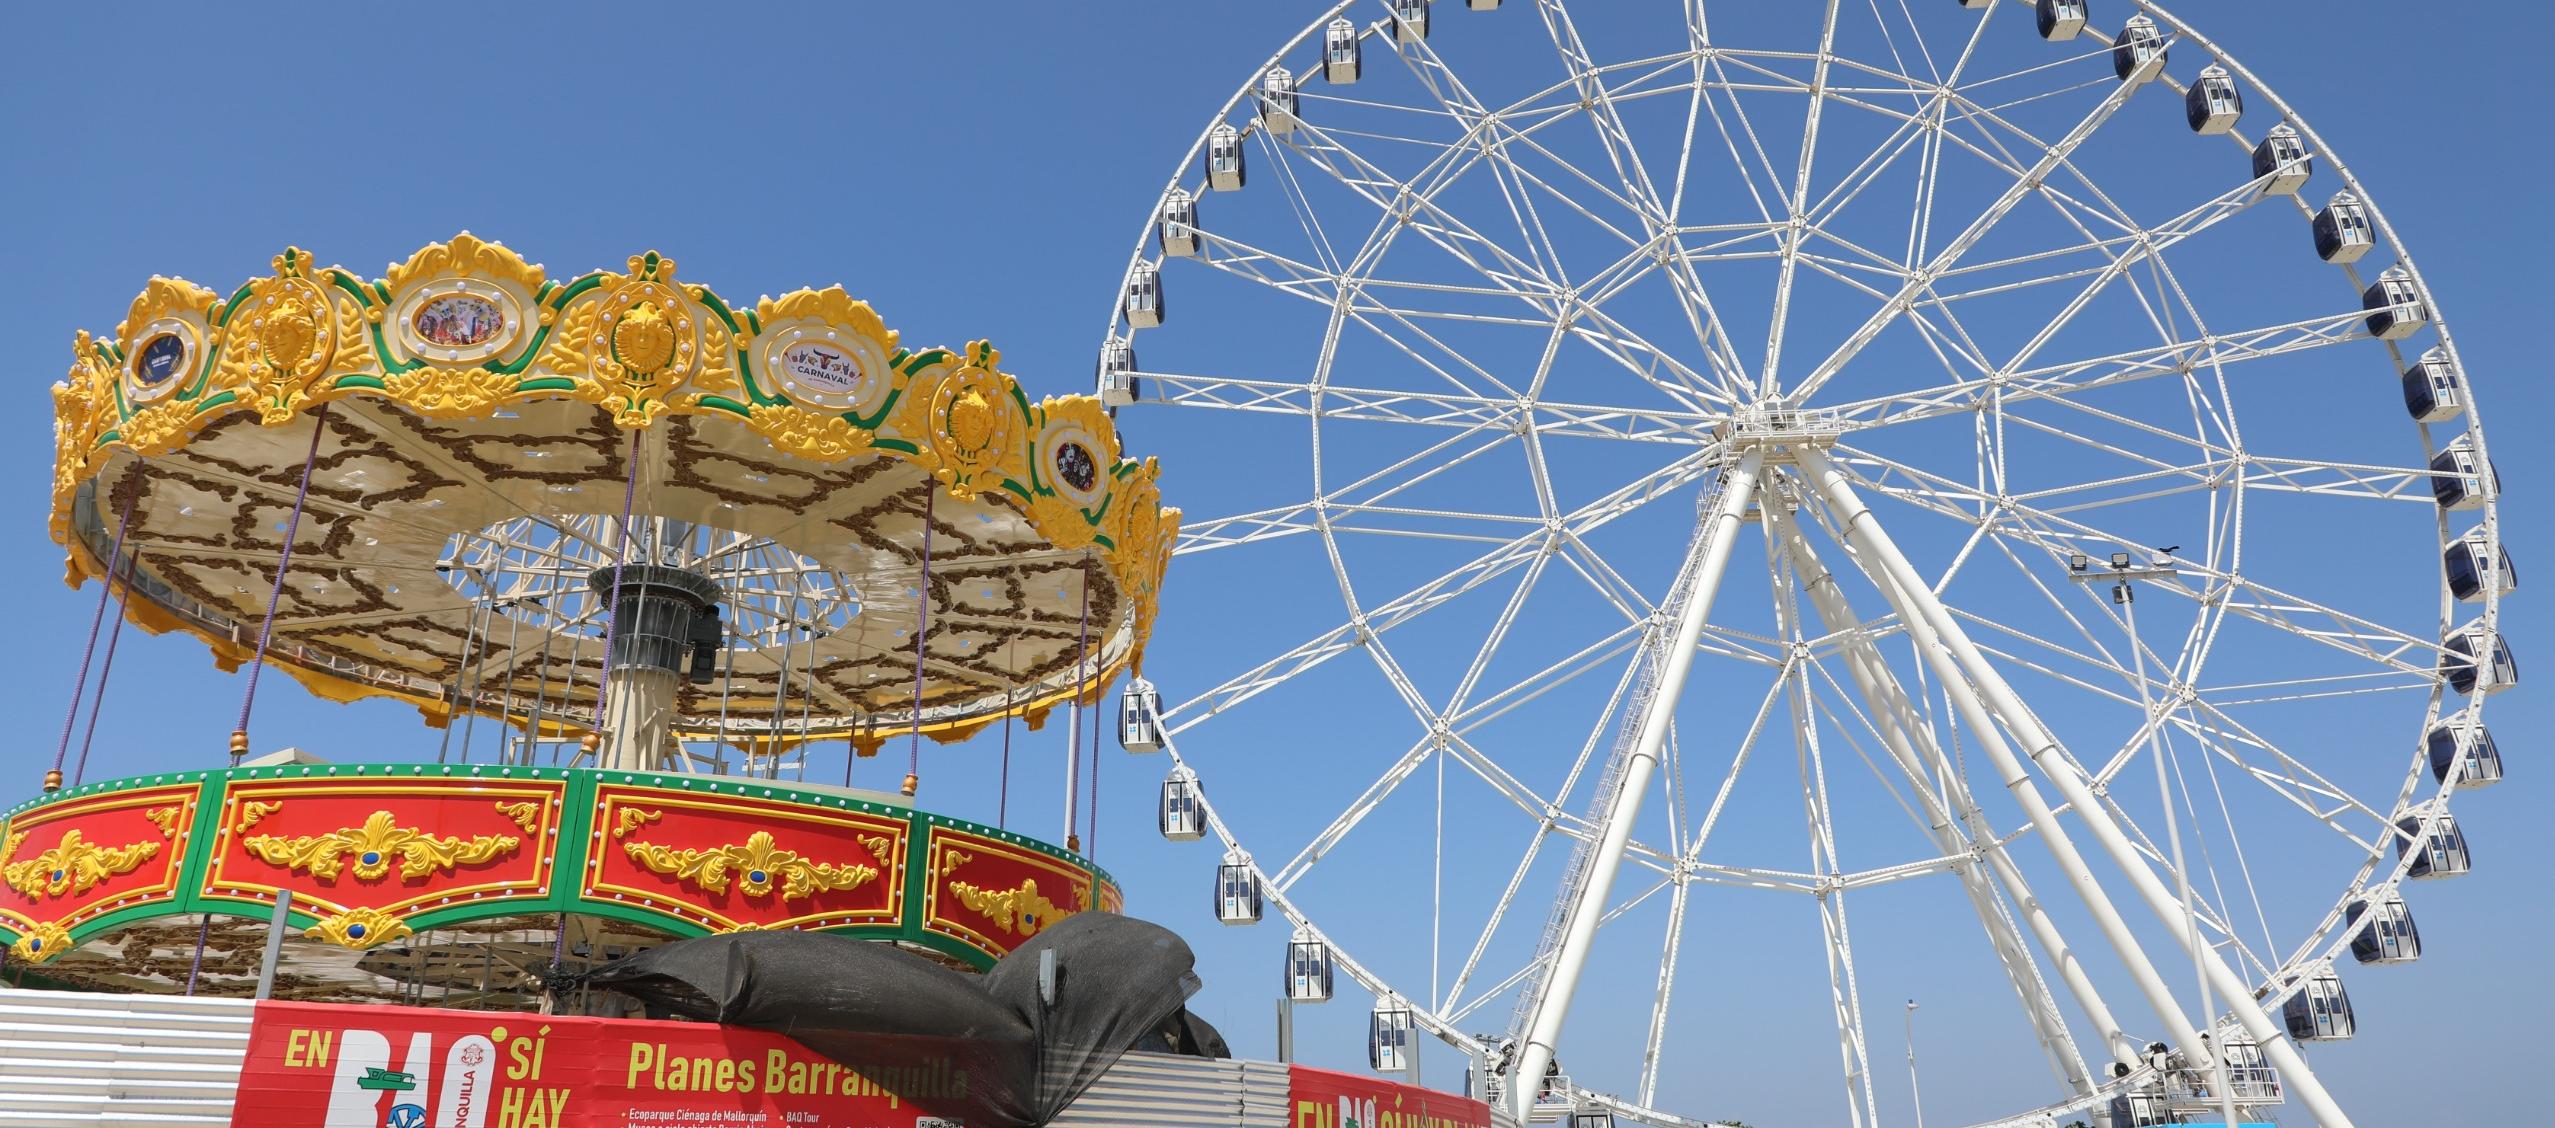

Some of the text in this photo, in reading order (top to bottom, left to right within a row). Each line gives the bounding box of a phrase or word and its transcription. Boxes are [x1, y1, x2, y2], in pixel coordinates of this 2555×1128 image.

[798, 366, 848, 385] CARNAVAL
[284, 1029, 333, 1068] EN
[507, 1025, 551, 1080] SÍ
[627, 1042, 969, 1109] Planes Barranquilla
[498, 1087, 570, 1128] HAY
[629, 1108, 767, 1124] Ecoparque Ciénaga de Mallorquín
[786, 1111, 820, 1123] BAQ Tour
